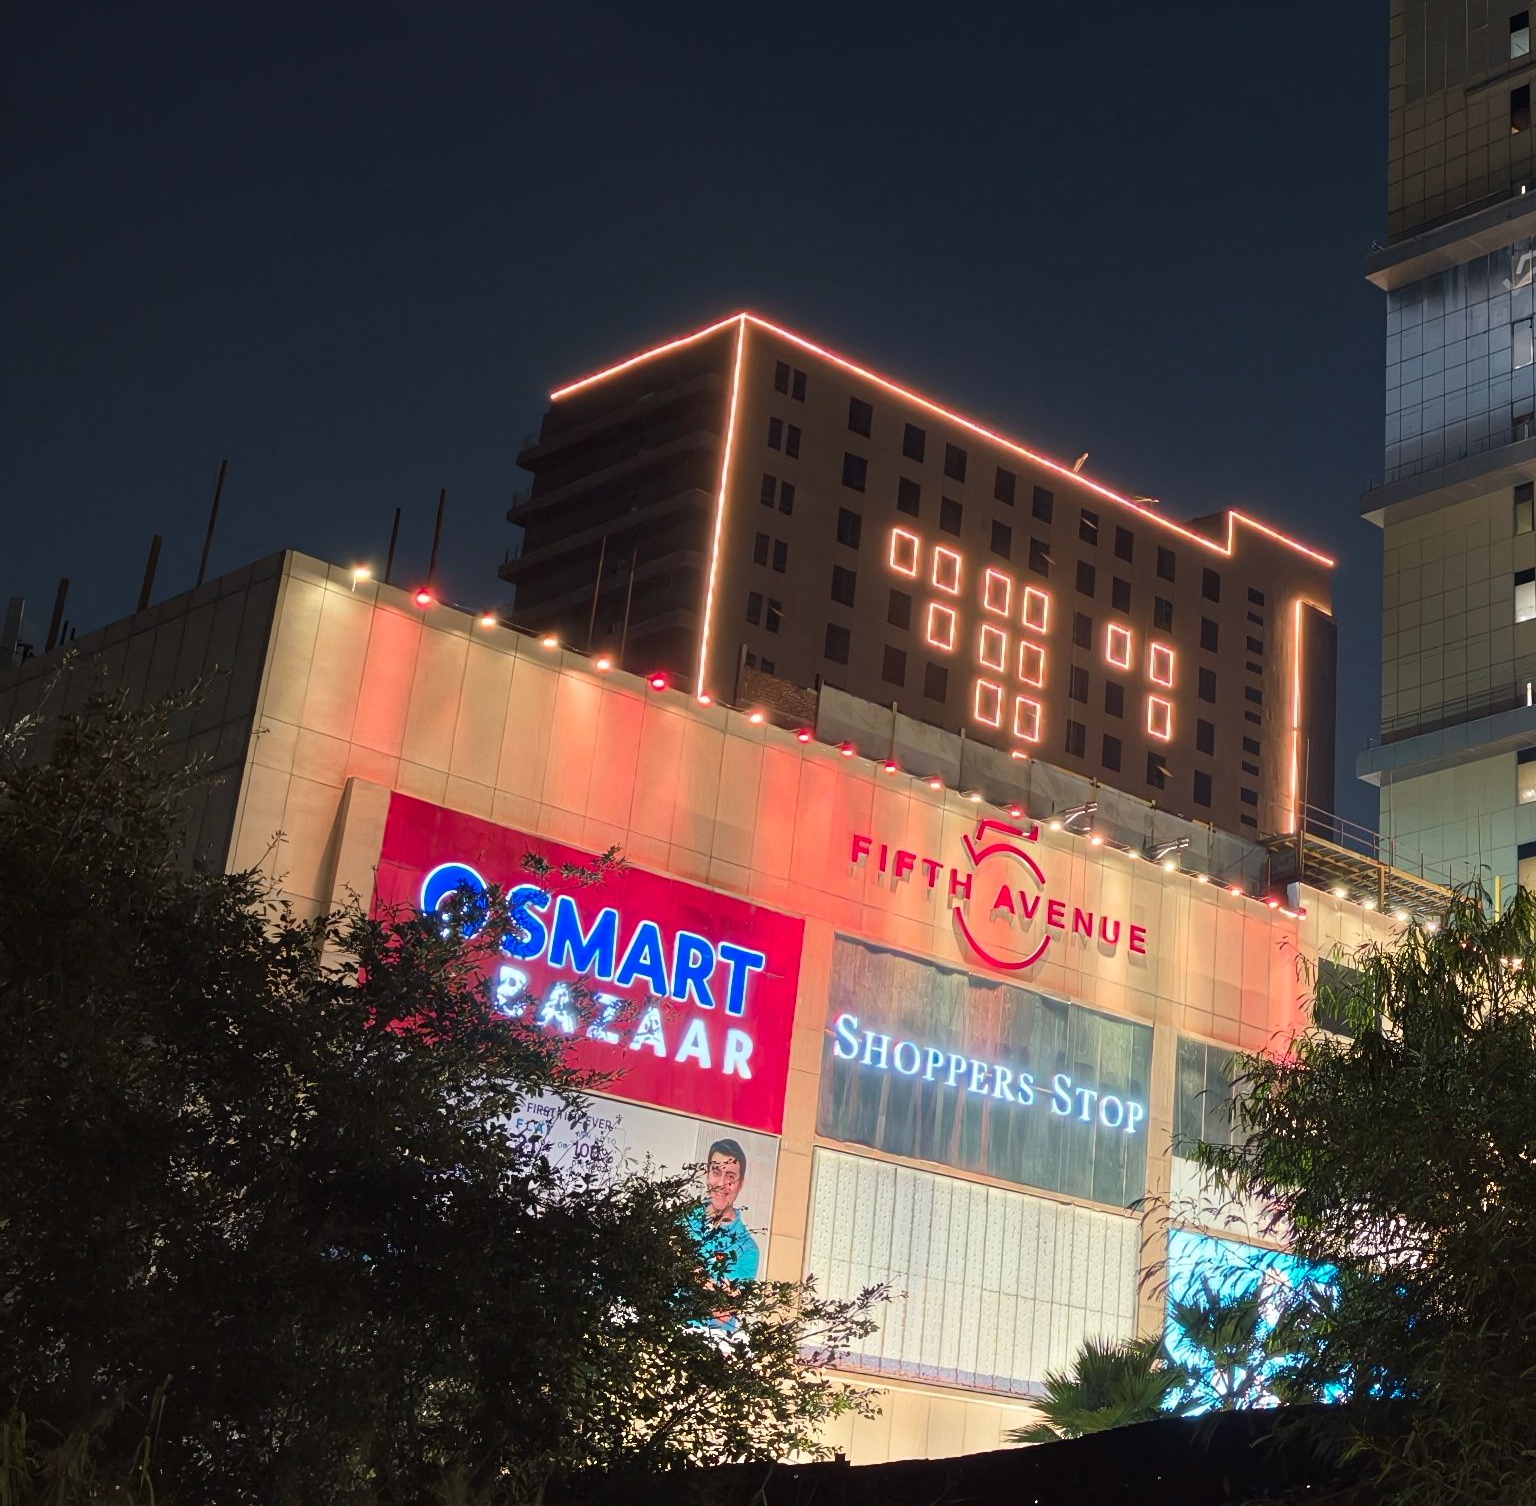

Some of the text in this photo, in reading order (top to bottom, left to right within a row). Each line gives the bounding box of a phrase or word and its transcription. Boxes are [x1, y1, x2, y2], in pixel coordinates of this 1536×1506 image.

[501, 884, 766, 1017] SMART
[851, 833, 1147, 955] FIFTH AVENUE
[496, 964, 755, 1080] BAZAAR
[833, 1012, 1145, 1134] SHOPPERS STOP
